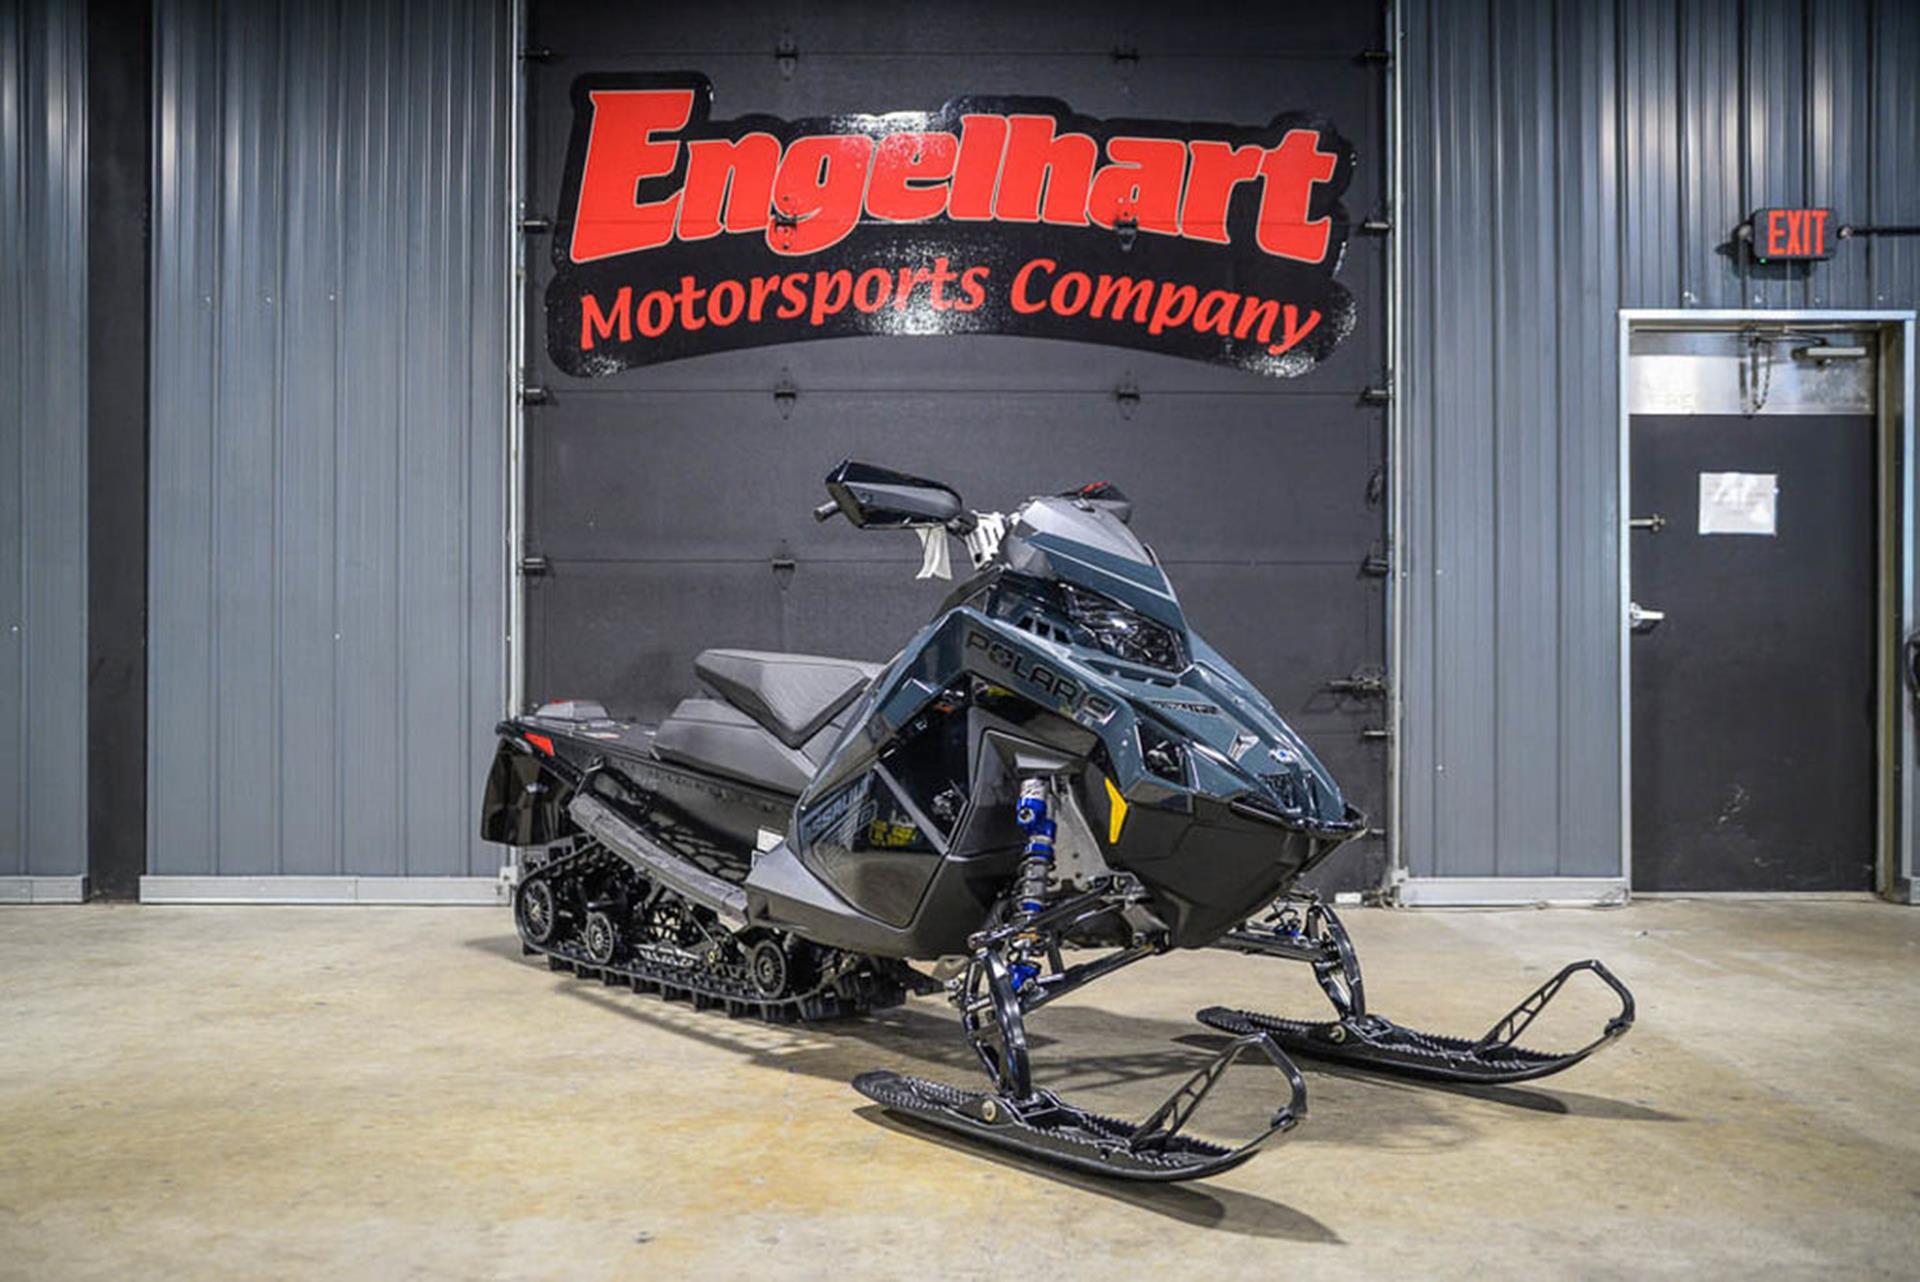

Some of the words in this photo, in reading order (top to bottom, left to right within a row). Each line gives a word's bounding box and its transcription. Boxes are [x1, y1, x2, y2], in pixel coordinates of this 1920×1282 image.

[571, 90, 1337, 263] Engelhart
[1768, 210, 1828, 256] EXIT
[580, 257, 990, 351] Motorsports
[1011, 258, 1322, 356] Company
[966, 631, 1115, 721] POLARIS
